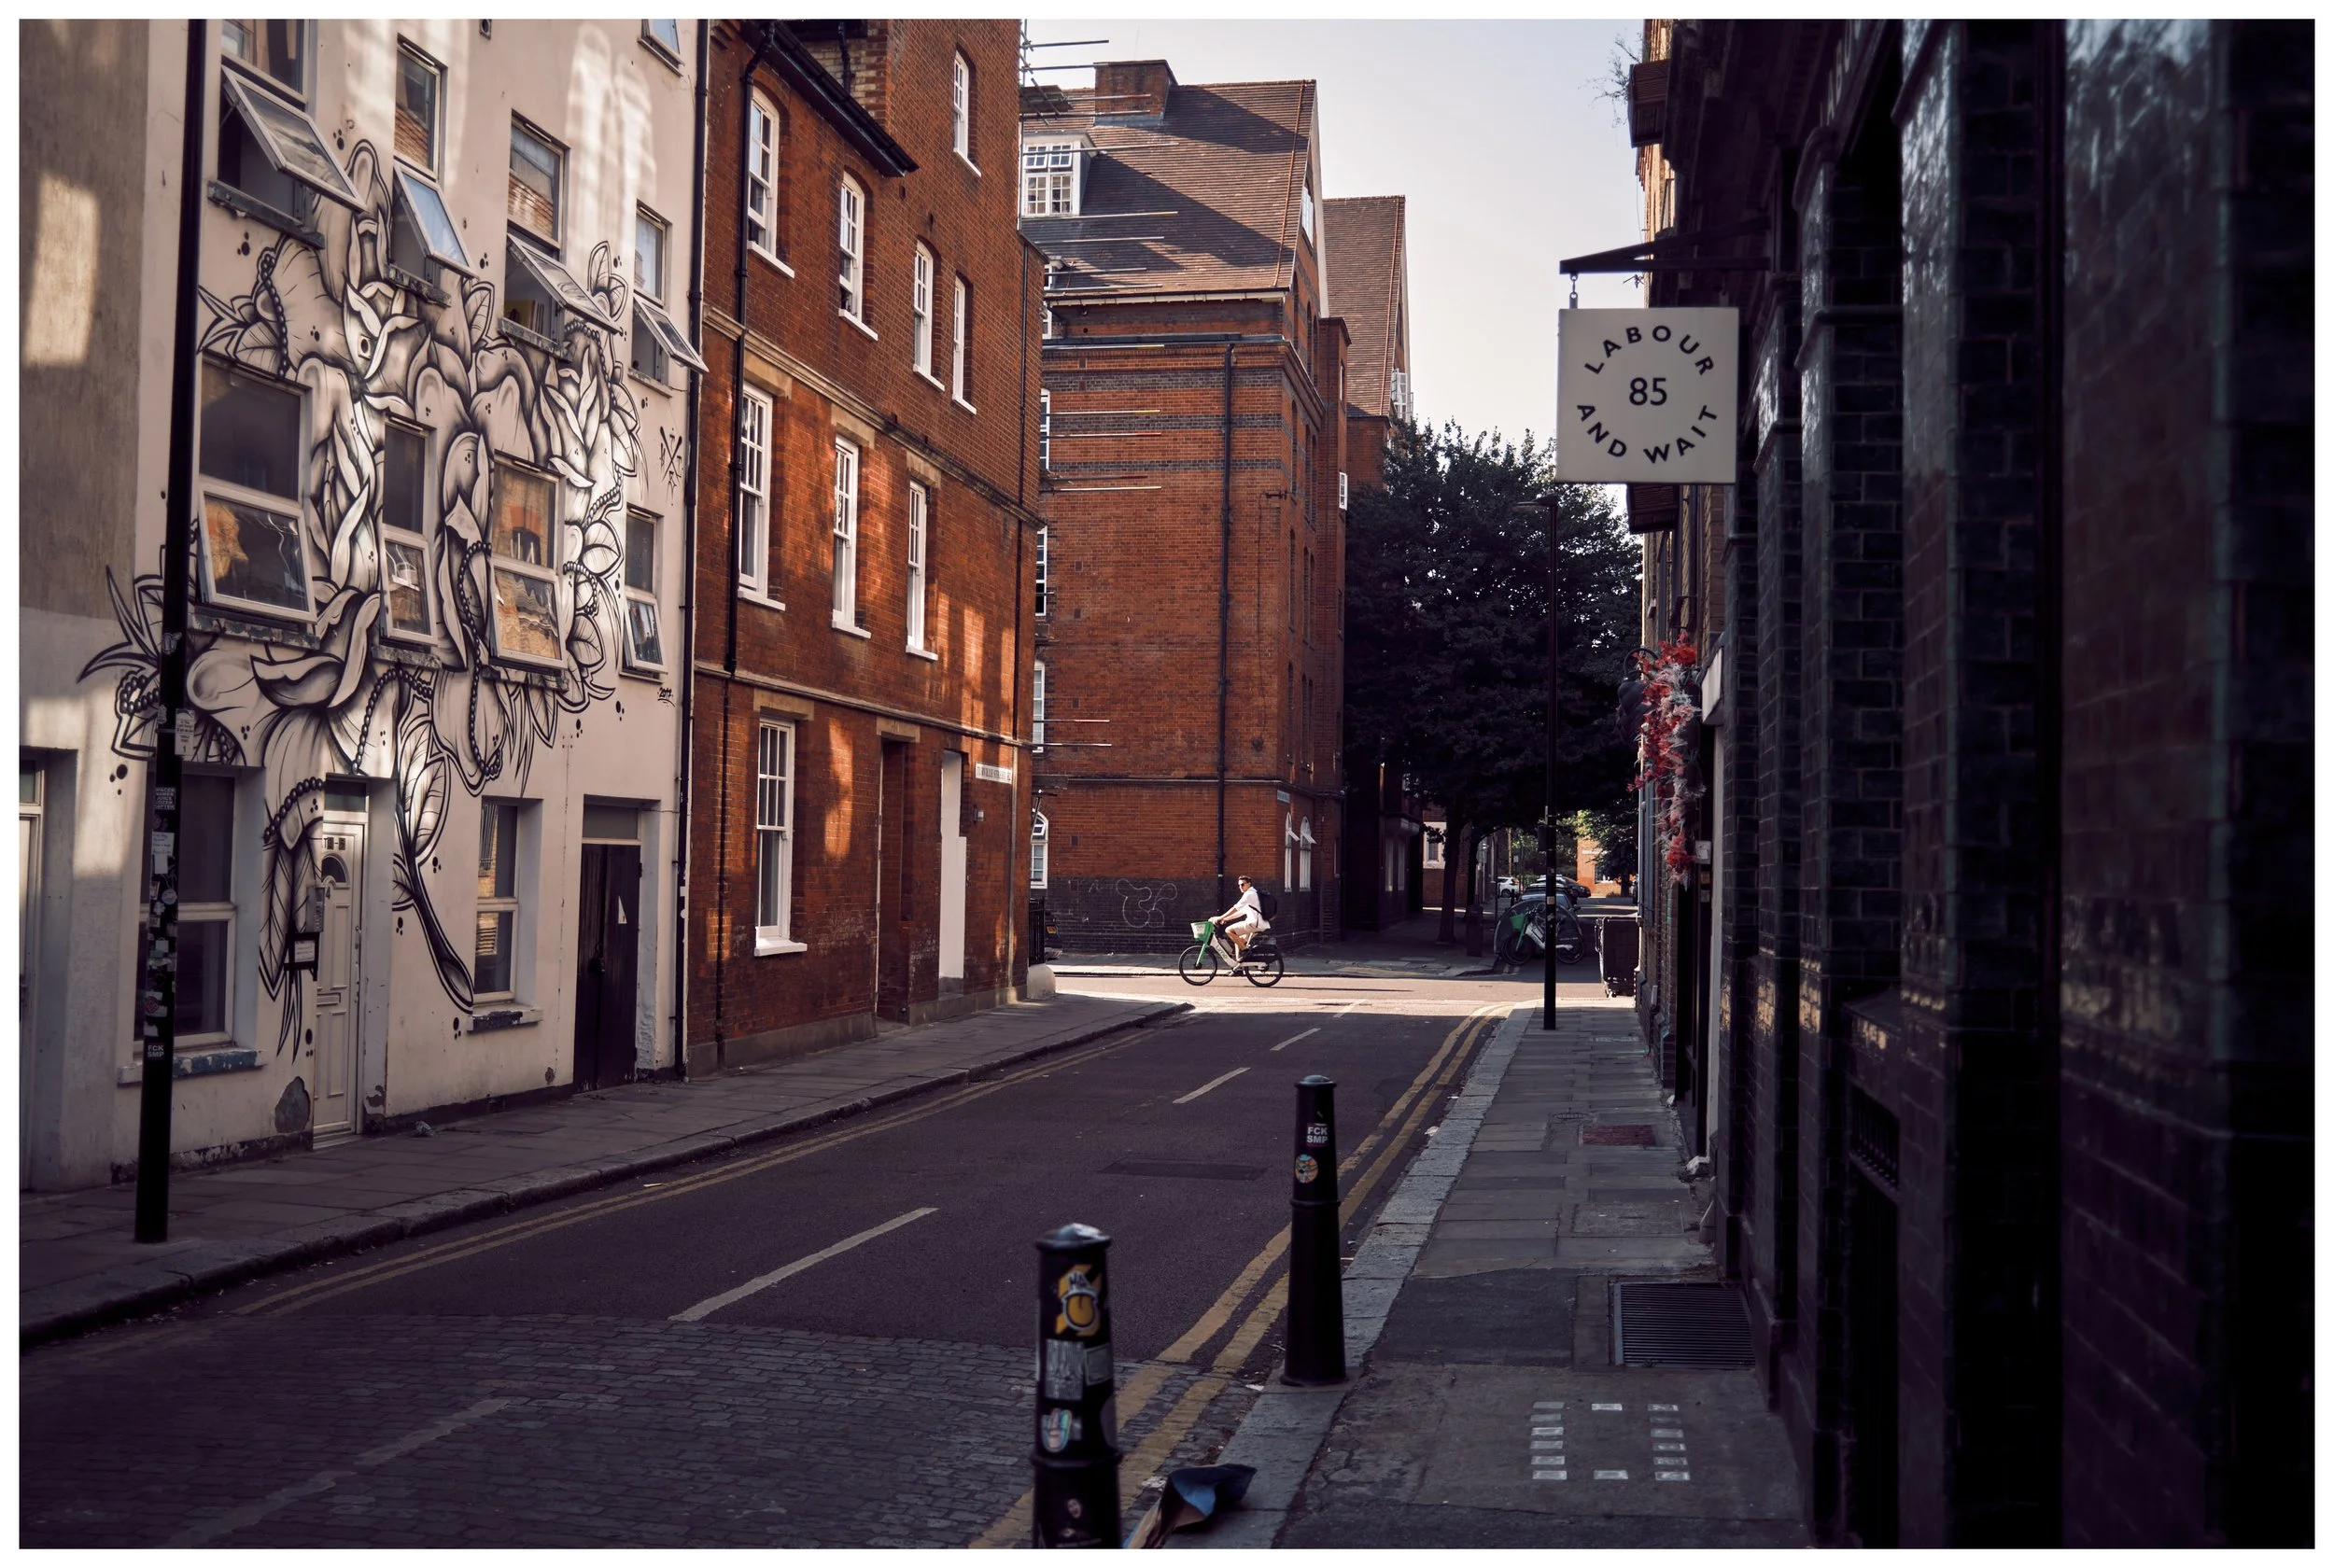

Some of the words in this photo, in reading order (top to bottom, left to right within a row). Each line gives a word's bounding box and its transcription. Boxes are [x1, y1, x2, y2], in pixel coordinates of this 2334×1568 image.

[1584, 325, 1714, 375] LABOUR
[1629, 377, 1667, 406] 85
[1577, 404, 1627, 457] AND
[1643, 405, 1717, 464] WAIT
[1306, 1135, 1329, 1143] SMP
[1307, 1127, 1328, 1135] FCK
